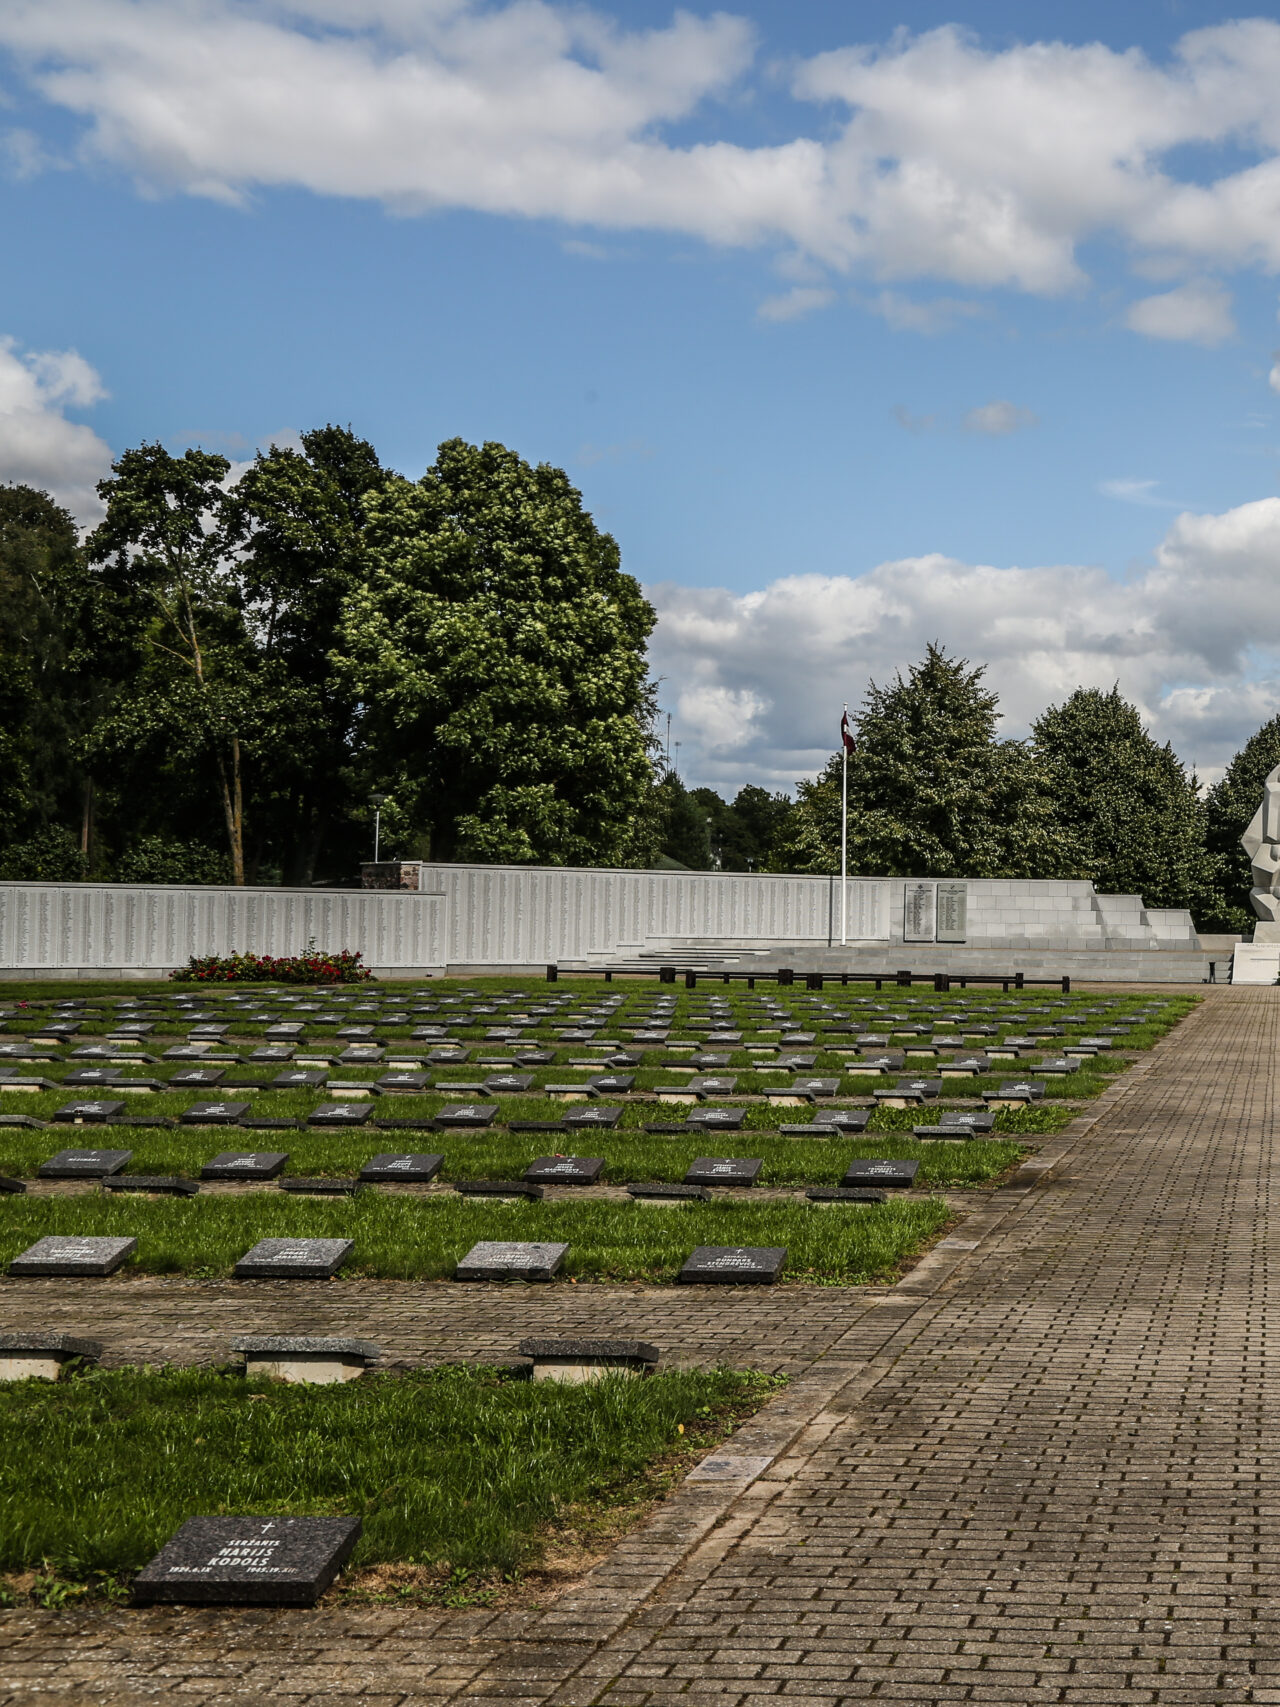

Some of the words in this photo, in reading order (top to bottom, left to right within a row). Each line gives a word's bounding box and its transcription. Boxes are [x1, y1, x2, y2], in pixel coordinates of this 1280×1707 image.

[228, 1538, 279, 1546] SERŽANTS
[219, 1547, 275, 1557] HARIJS
[208, 1557, 270, 1566] KODOLS
